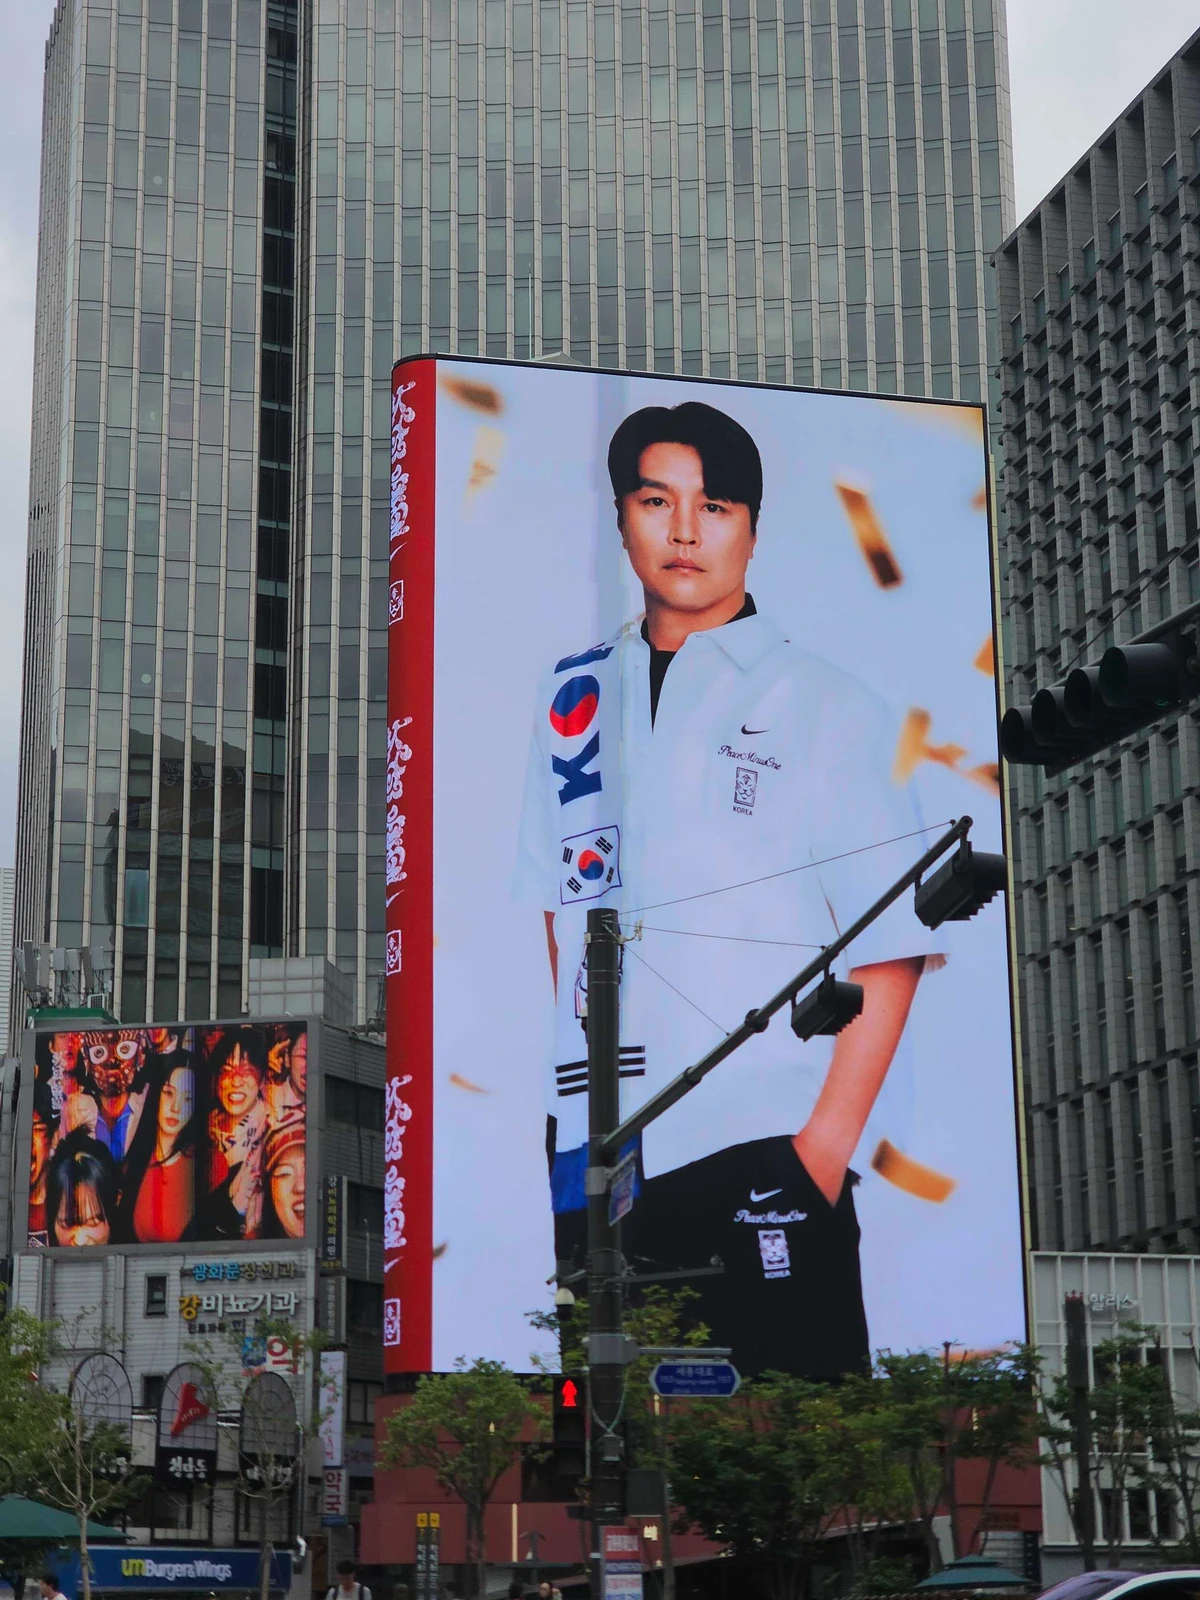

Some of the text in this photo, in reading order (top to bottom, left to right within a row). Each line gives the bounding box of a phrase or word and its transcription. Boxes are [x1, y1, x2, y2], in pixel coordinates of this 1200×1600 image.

[717, 744, 782, 771] PeaceMinusOne
[732, 805, 753, 816] KOREA
[178, 1291, 300, 1321] 강비뇨기과
